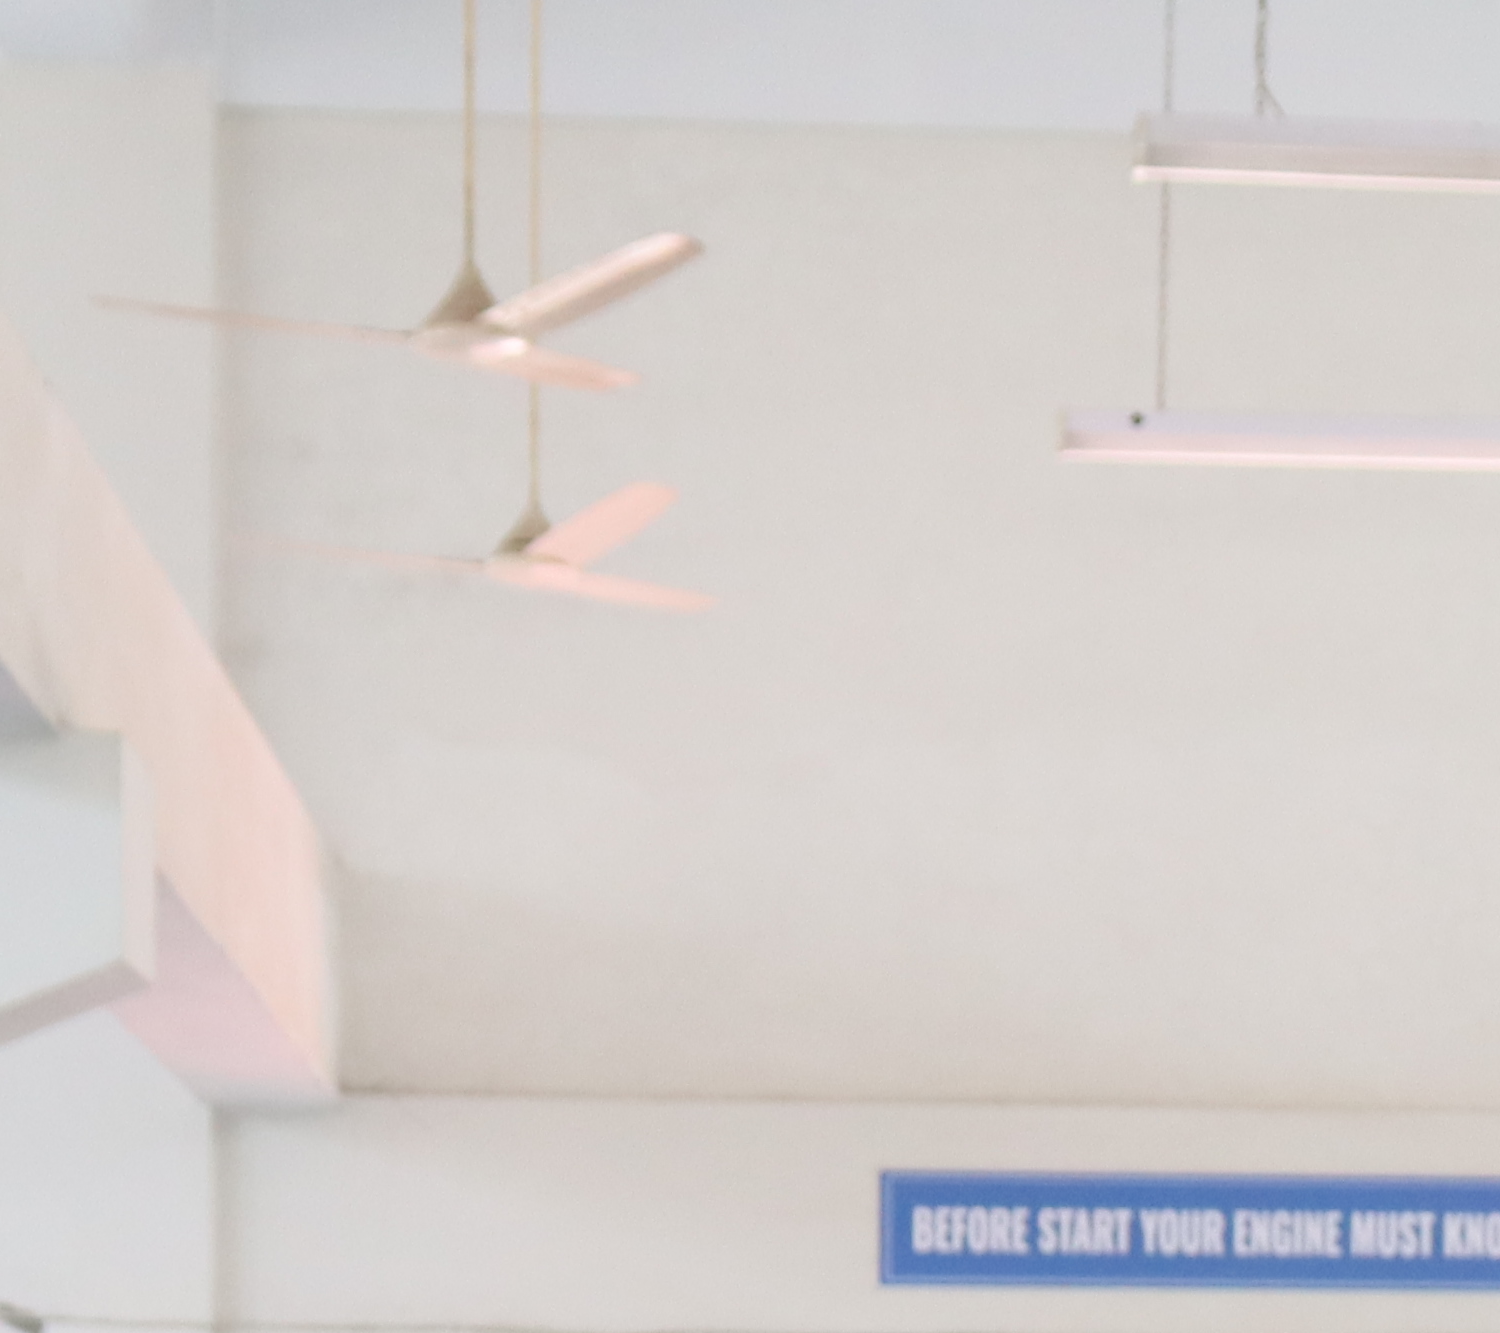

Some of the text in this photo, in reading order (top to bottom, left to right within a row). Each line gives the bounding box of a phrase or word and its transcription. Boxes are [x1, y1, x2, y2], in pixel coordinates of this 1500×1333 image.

[911, 1206, 1030, 1254] BEFORE
[1037, 1207, 1132, 1255] START
[1140, 1208, 1225, 1256] YOUR
[1233, 1209, 1343, 1258] ENGINE
[1350, 1210, 1436, 1258] MUST
